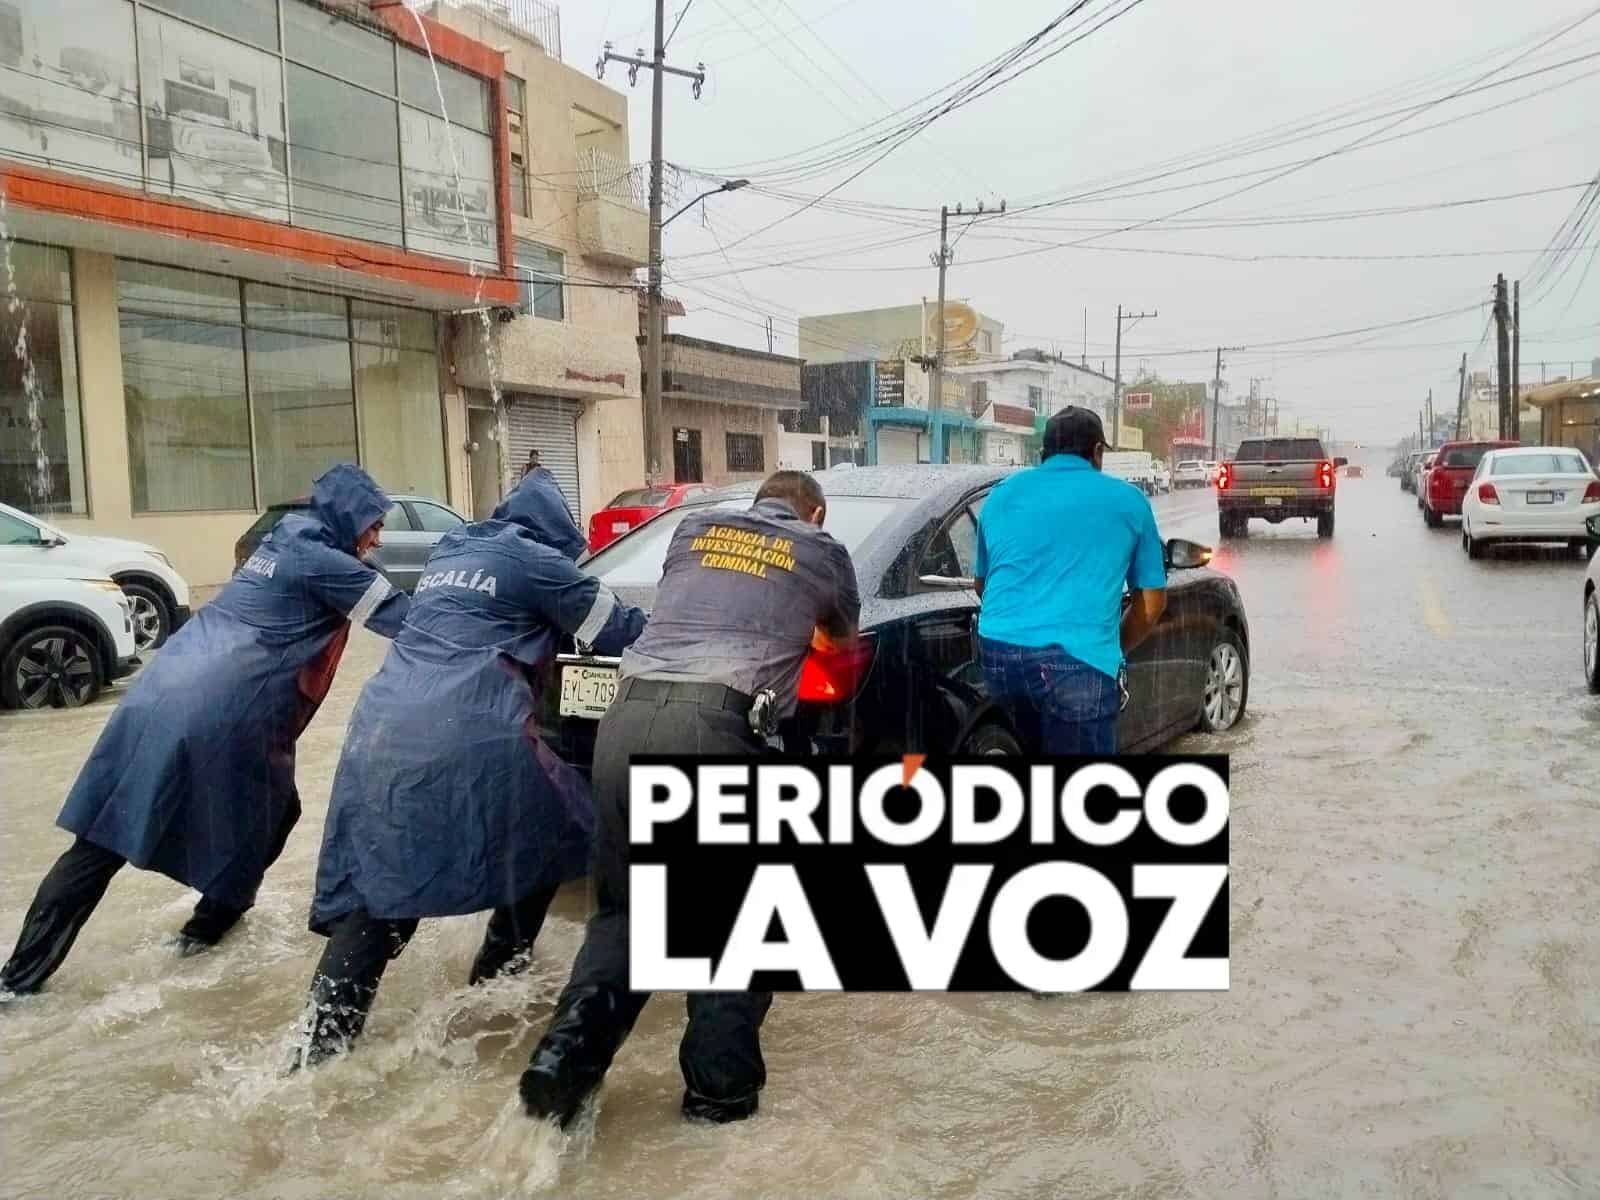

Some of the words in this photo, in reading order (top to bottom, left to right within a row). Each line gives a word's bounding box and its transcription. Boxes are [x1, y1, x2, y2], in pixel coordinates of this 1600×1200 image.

[706, 525, 767, 547] AGENCIA
[773, 537, 795, 553] DE
[701, 552, 767, 579] CRIMINAL
